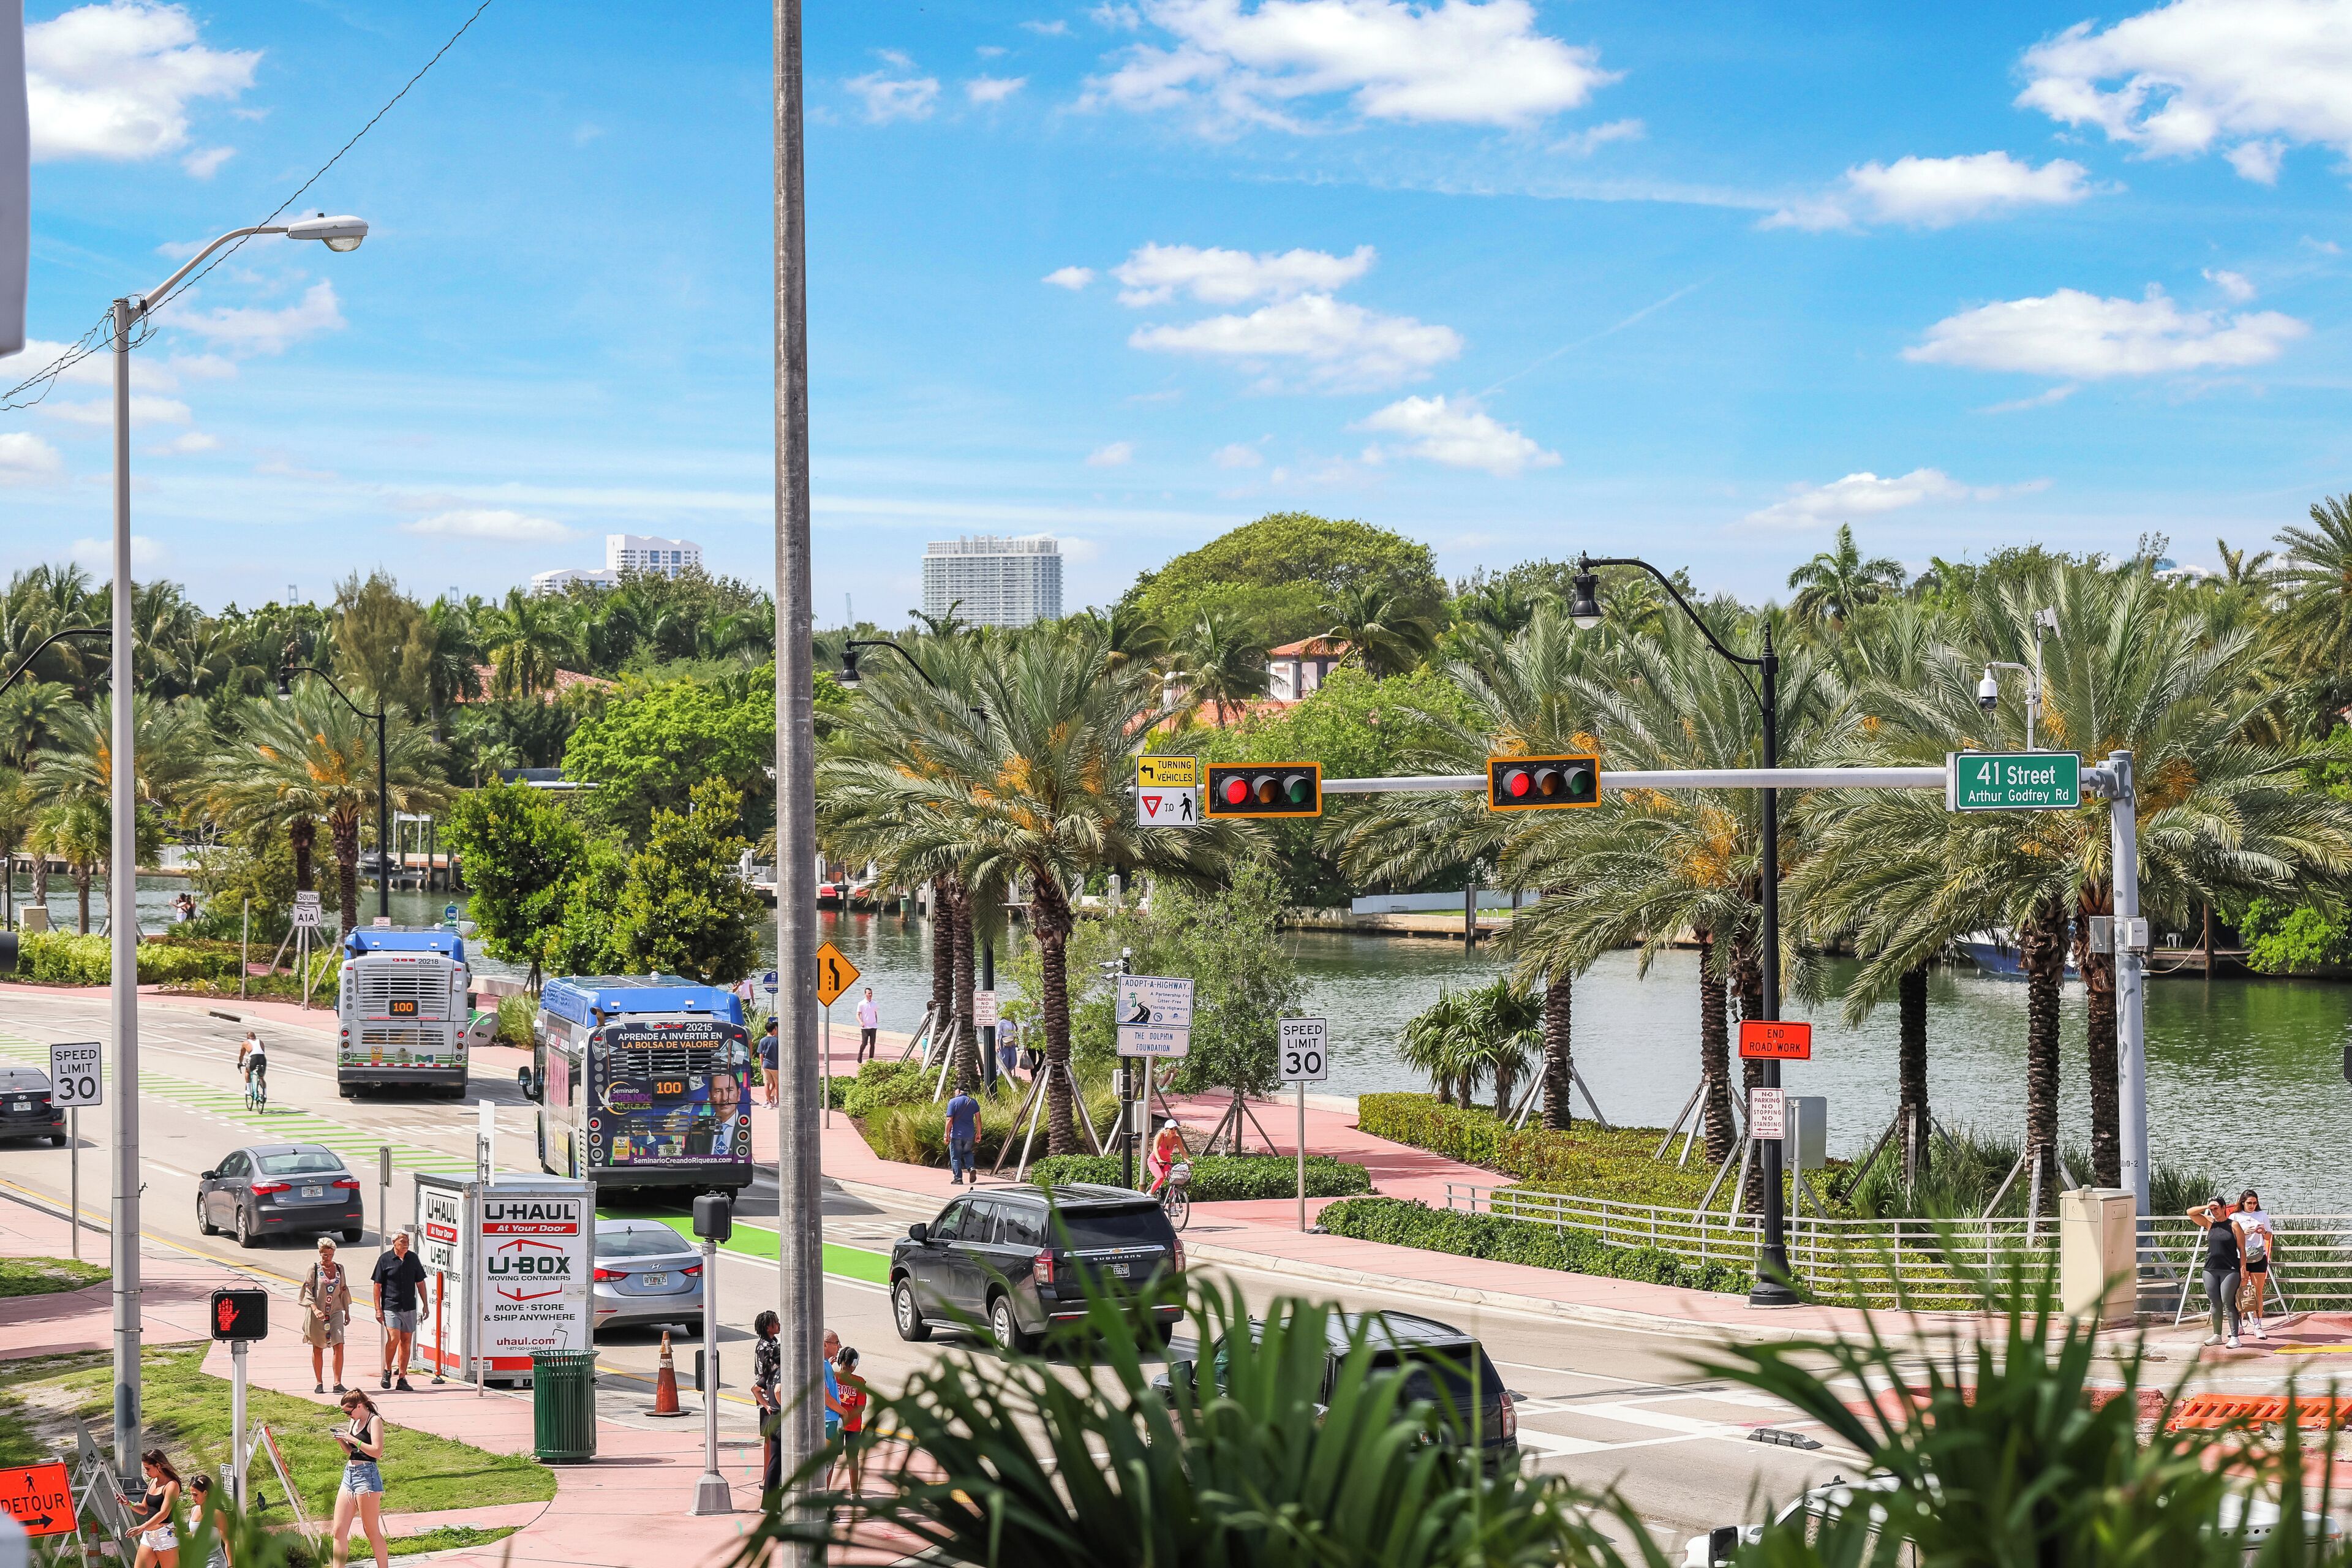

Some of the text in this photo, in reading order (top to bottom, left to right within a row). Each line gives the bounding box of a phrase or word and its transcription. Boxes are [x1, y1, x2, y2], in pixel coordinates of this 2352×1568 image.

[1158, 761, 1191, 769] TURNING
[1157, 773, 1193, 782] VEHICLES
[1977, 761, 2056, 785] 41 Street
[1968, 788, 2070, 804] Arthur Godfrey Rd
[1164, 803, 1174, 812] TO
[298, 913, 315, 922] A1A
[1125, 979, 1187, 989] ADOPT-A-HIGHWAY
[393, 1002, 413, 1012] 100
[686, 1023, 712, 1031] 20215
[1283, 1025, 1322, 1035] SPEED
[1150, 1032, 1173, 1041] DOLPHIN
[1768, 1029, 1784, 1038] END
[1136, 1043, 1170, 1052] FOUNDATION
[1287, 1039, 1318, 1048] LIMIT
[1749, 1042, 1801, 1052] ROAD WORK
[55, 1050, 97, 1061] SPEED
[1285, 1051, 1322, 1074] 30
[60, 1063, 92, 1074] LIMIT
[58, 1076, 96, 1100] 30
[657, 1082, 682, 1093] 100
[633, 1156, 732, 1165] SeminarioCreandoRiqueza.com
[427, 1198, 457, 1224] U-HAUL
[485, 1204, 575, 1220] U-HAUL
[444, 1230, 454, 1238] Door
[431, 1246, 451, 1267] U-BOX
[488, 1256, 570, 1274] U-BOX
[497, 1336, 555, 1346] uhaul.com
[837, 1384, 857, 1396] RUE
[1, 1493, 66, 1515] DETOUR
